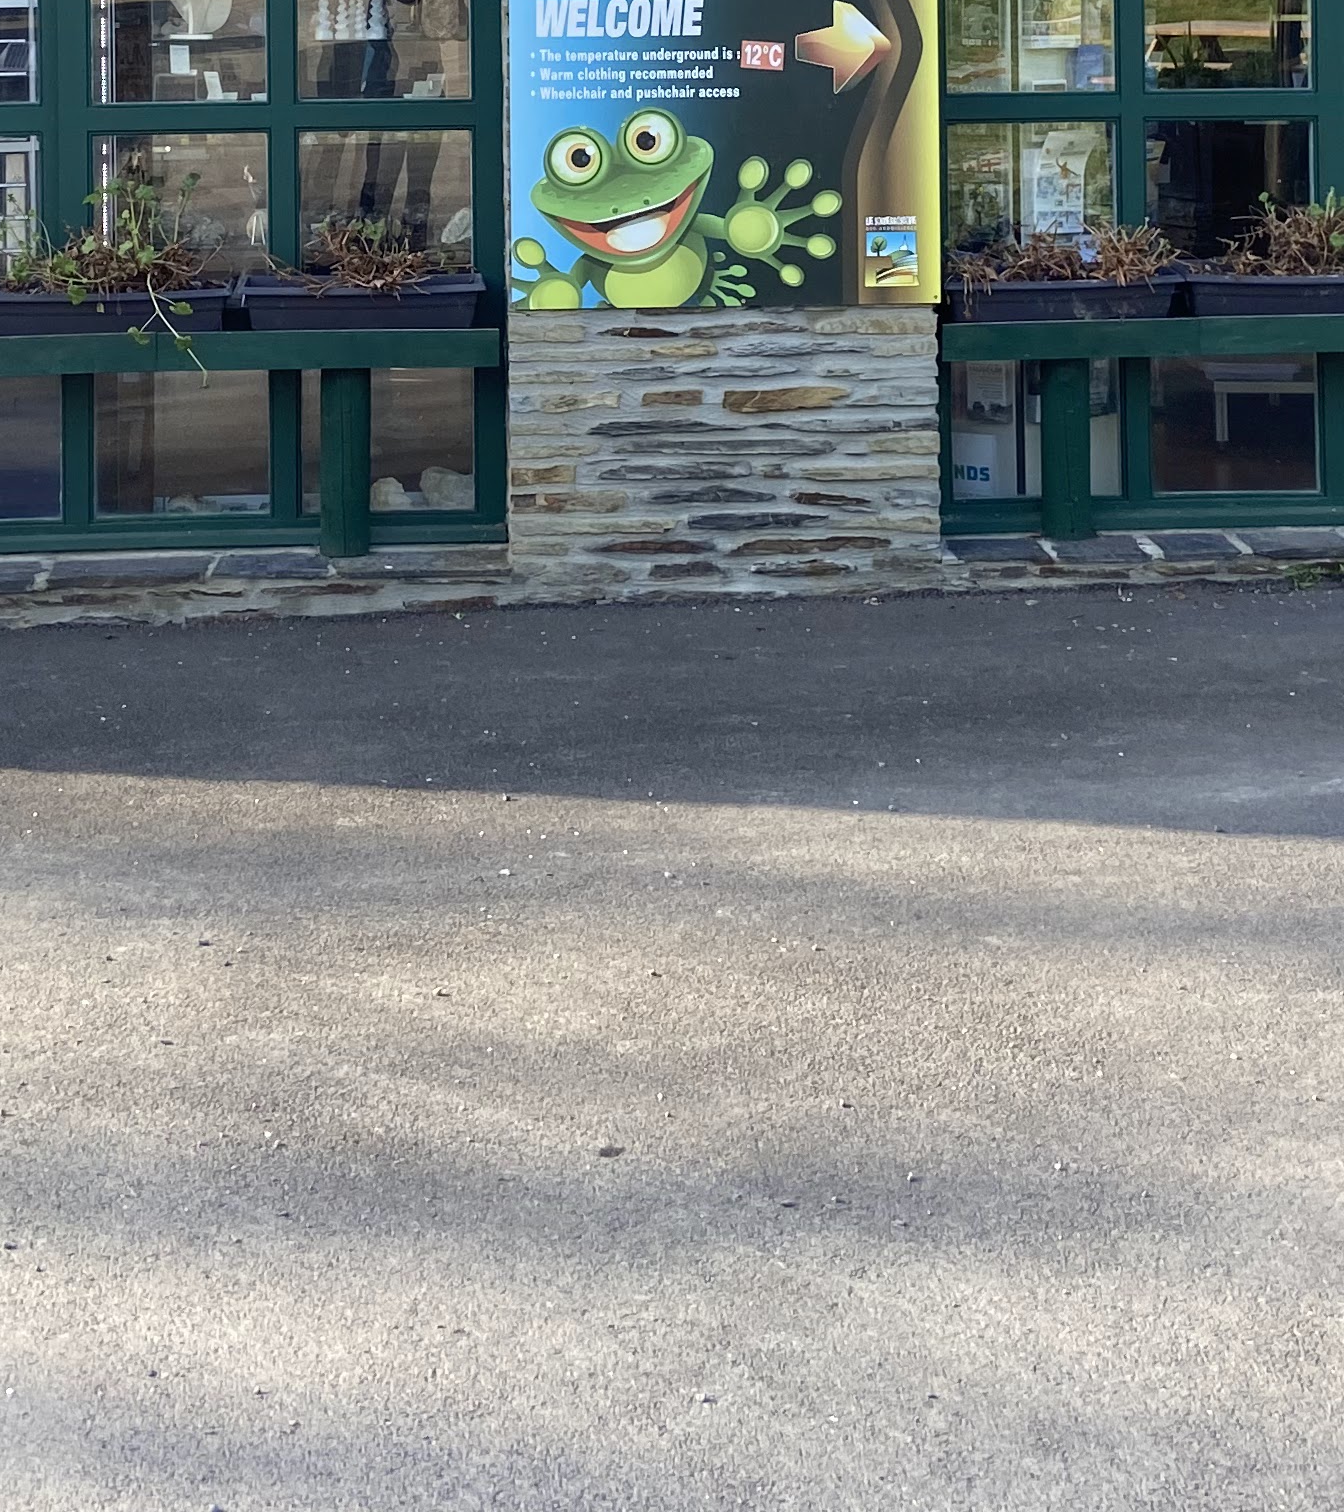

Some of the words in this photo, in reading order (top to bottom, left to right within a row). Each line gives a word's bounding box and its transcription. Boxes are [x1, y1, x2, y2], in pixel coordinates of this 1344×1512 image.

[539, 48, 562, 62] The
[565, 49, 639, 65] temperature
[642, 46, 719, 65] underground
[722, 47, 733, 60] is
[744, 43, 783, 67] 12°C
[539, 67, 574, 81] Warm
[577, 66, 626, 83] clothing
[629, 65, 714, 80] recommended
[539, 86, 607, 100] Wheelchair
[610, 86, 633, 100] and
[636, 84, 696, 102] pushchair
[698, 86, 740, 99] access
